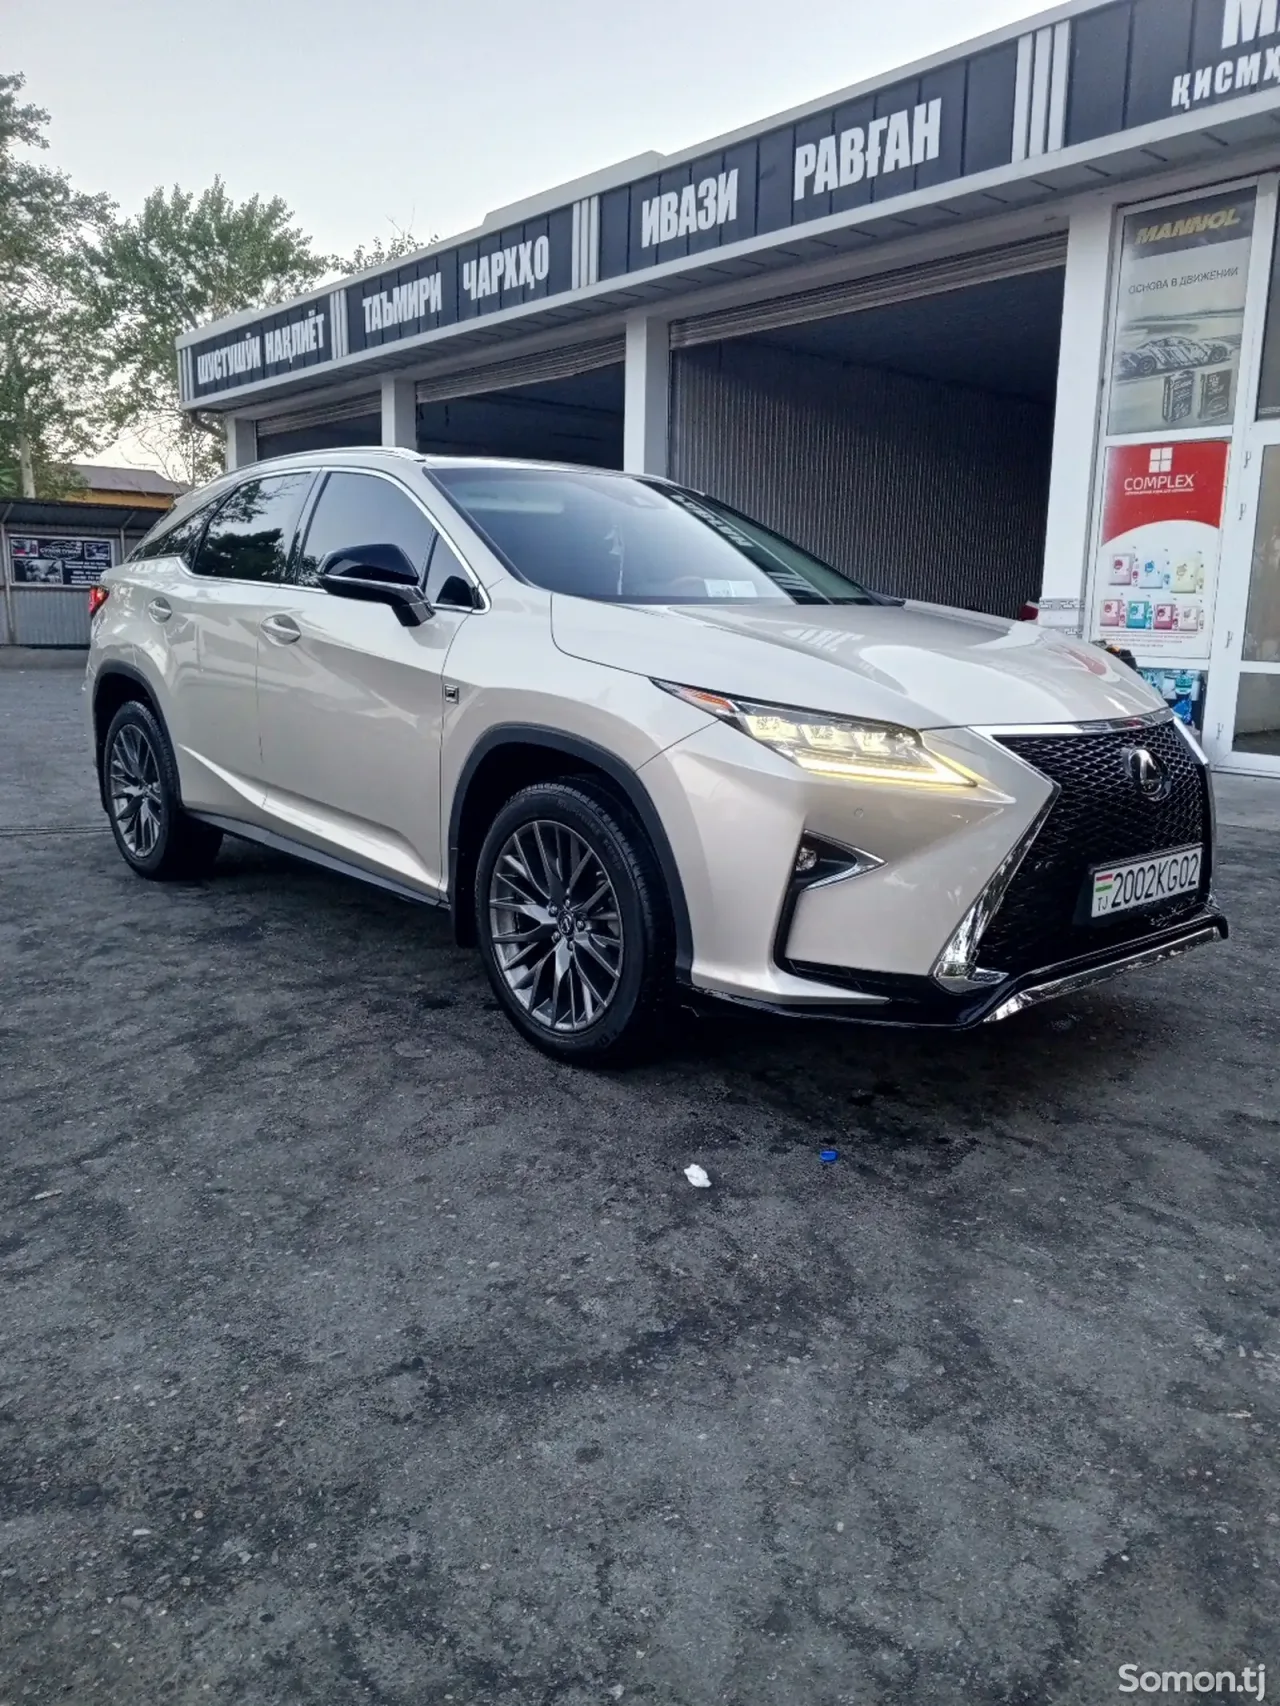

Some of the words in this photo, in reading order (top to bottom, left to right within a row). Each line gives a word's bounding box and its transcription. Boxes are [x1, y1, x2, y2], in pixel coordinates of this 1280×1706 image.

[1221, 0, 1280, 49] М
[641, 168, 738, 249] ИВАЗИ
[793, 97, 942, 202] РАВҒАН
[1134, 208, 1241, 246] MANNOL
[362, 272, 442, 334] ТАЪМИРИ
[462, 235, 550, 301] ЧАРХҲО
[1128, 279, 1169, 295] ОСНОВА
[1170, 277, 1178, 288] В
[1179, 266, 1239, 288] ДВИЖЕНИИ
[264, 310, 325, 364] НАҚЛИЁТ
[1124, 474, 1195, 491] COMPLEX
[1097, 896, 1109, 912] TJ
[1111, 853, 1200, 909] 2002KG02
